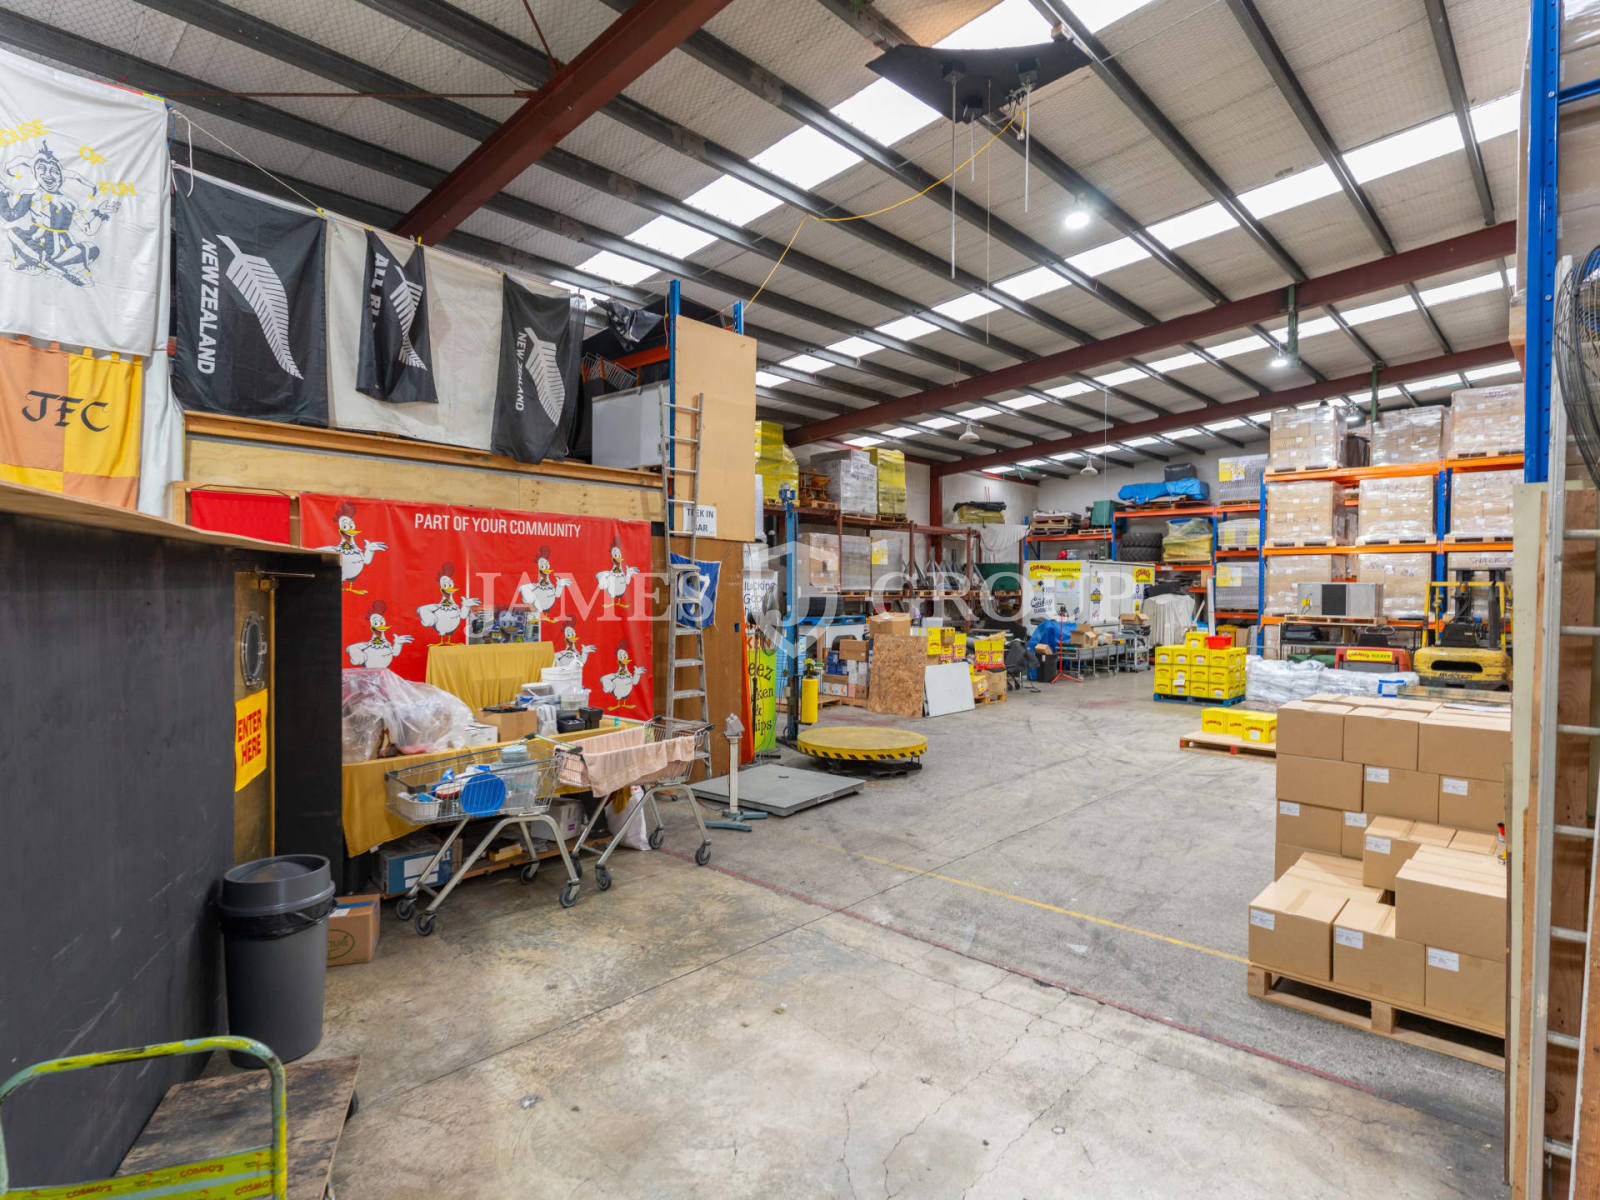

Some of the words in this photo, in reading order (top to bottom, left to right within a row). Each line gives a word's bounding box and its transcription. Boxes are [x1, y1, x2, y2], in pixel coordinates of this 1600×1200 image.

[79, 146, 107, 165] OF
[98, 181, 136, 196] FUN
[516, 332, 528, 360] NEW
[22, 390, 110, 432] JFC
[415, 513, 450, 530] PART
[453, 516, 469, 531] OF
[472, 517, 507, 534] YOUR
[510, 520, 581, 538] COMMUNITY
[237, 708, 262, 743] ENTER
[241, 733, 262, 767] HERE
